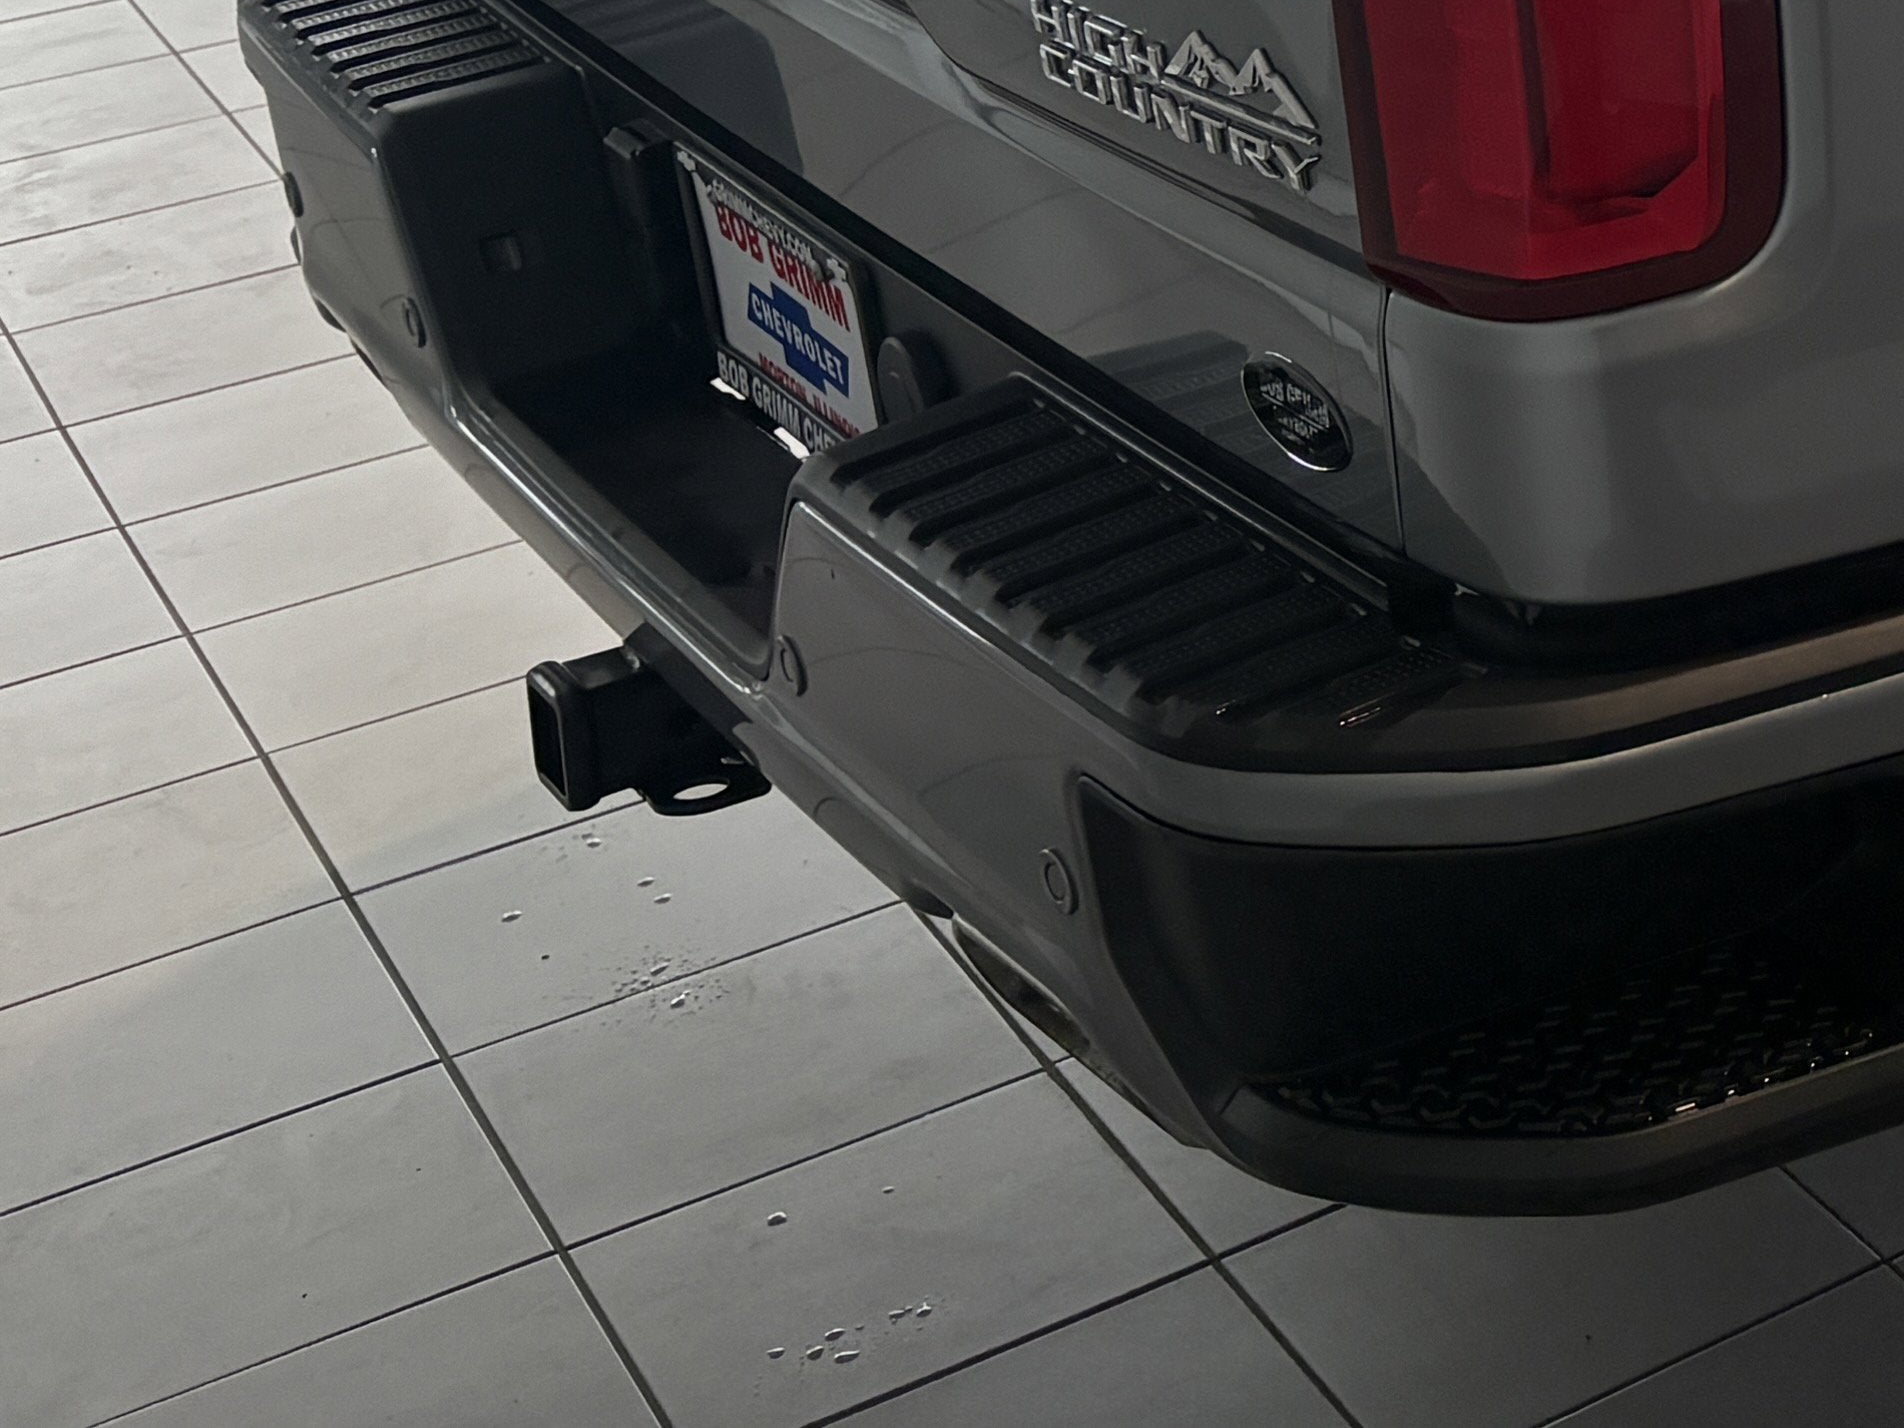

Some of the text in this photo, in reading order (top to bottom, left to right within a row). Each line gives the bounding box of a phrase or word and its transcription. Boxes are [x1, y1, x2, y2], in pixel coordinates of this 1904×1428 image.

[1039, 38, 1322, 191] COUNTRY
[715, 202, 851, 333] BOB GRIMM
[717, 350, 750, 398] BOB
[751, 376, 802, 438] GRIMM
[751, 291, 845, 385] CHEVROLET
